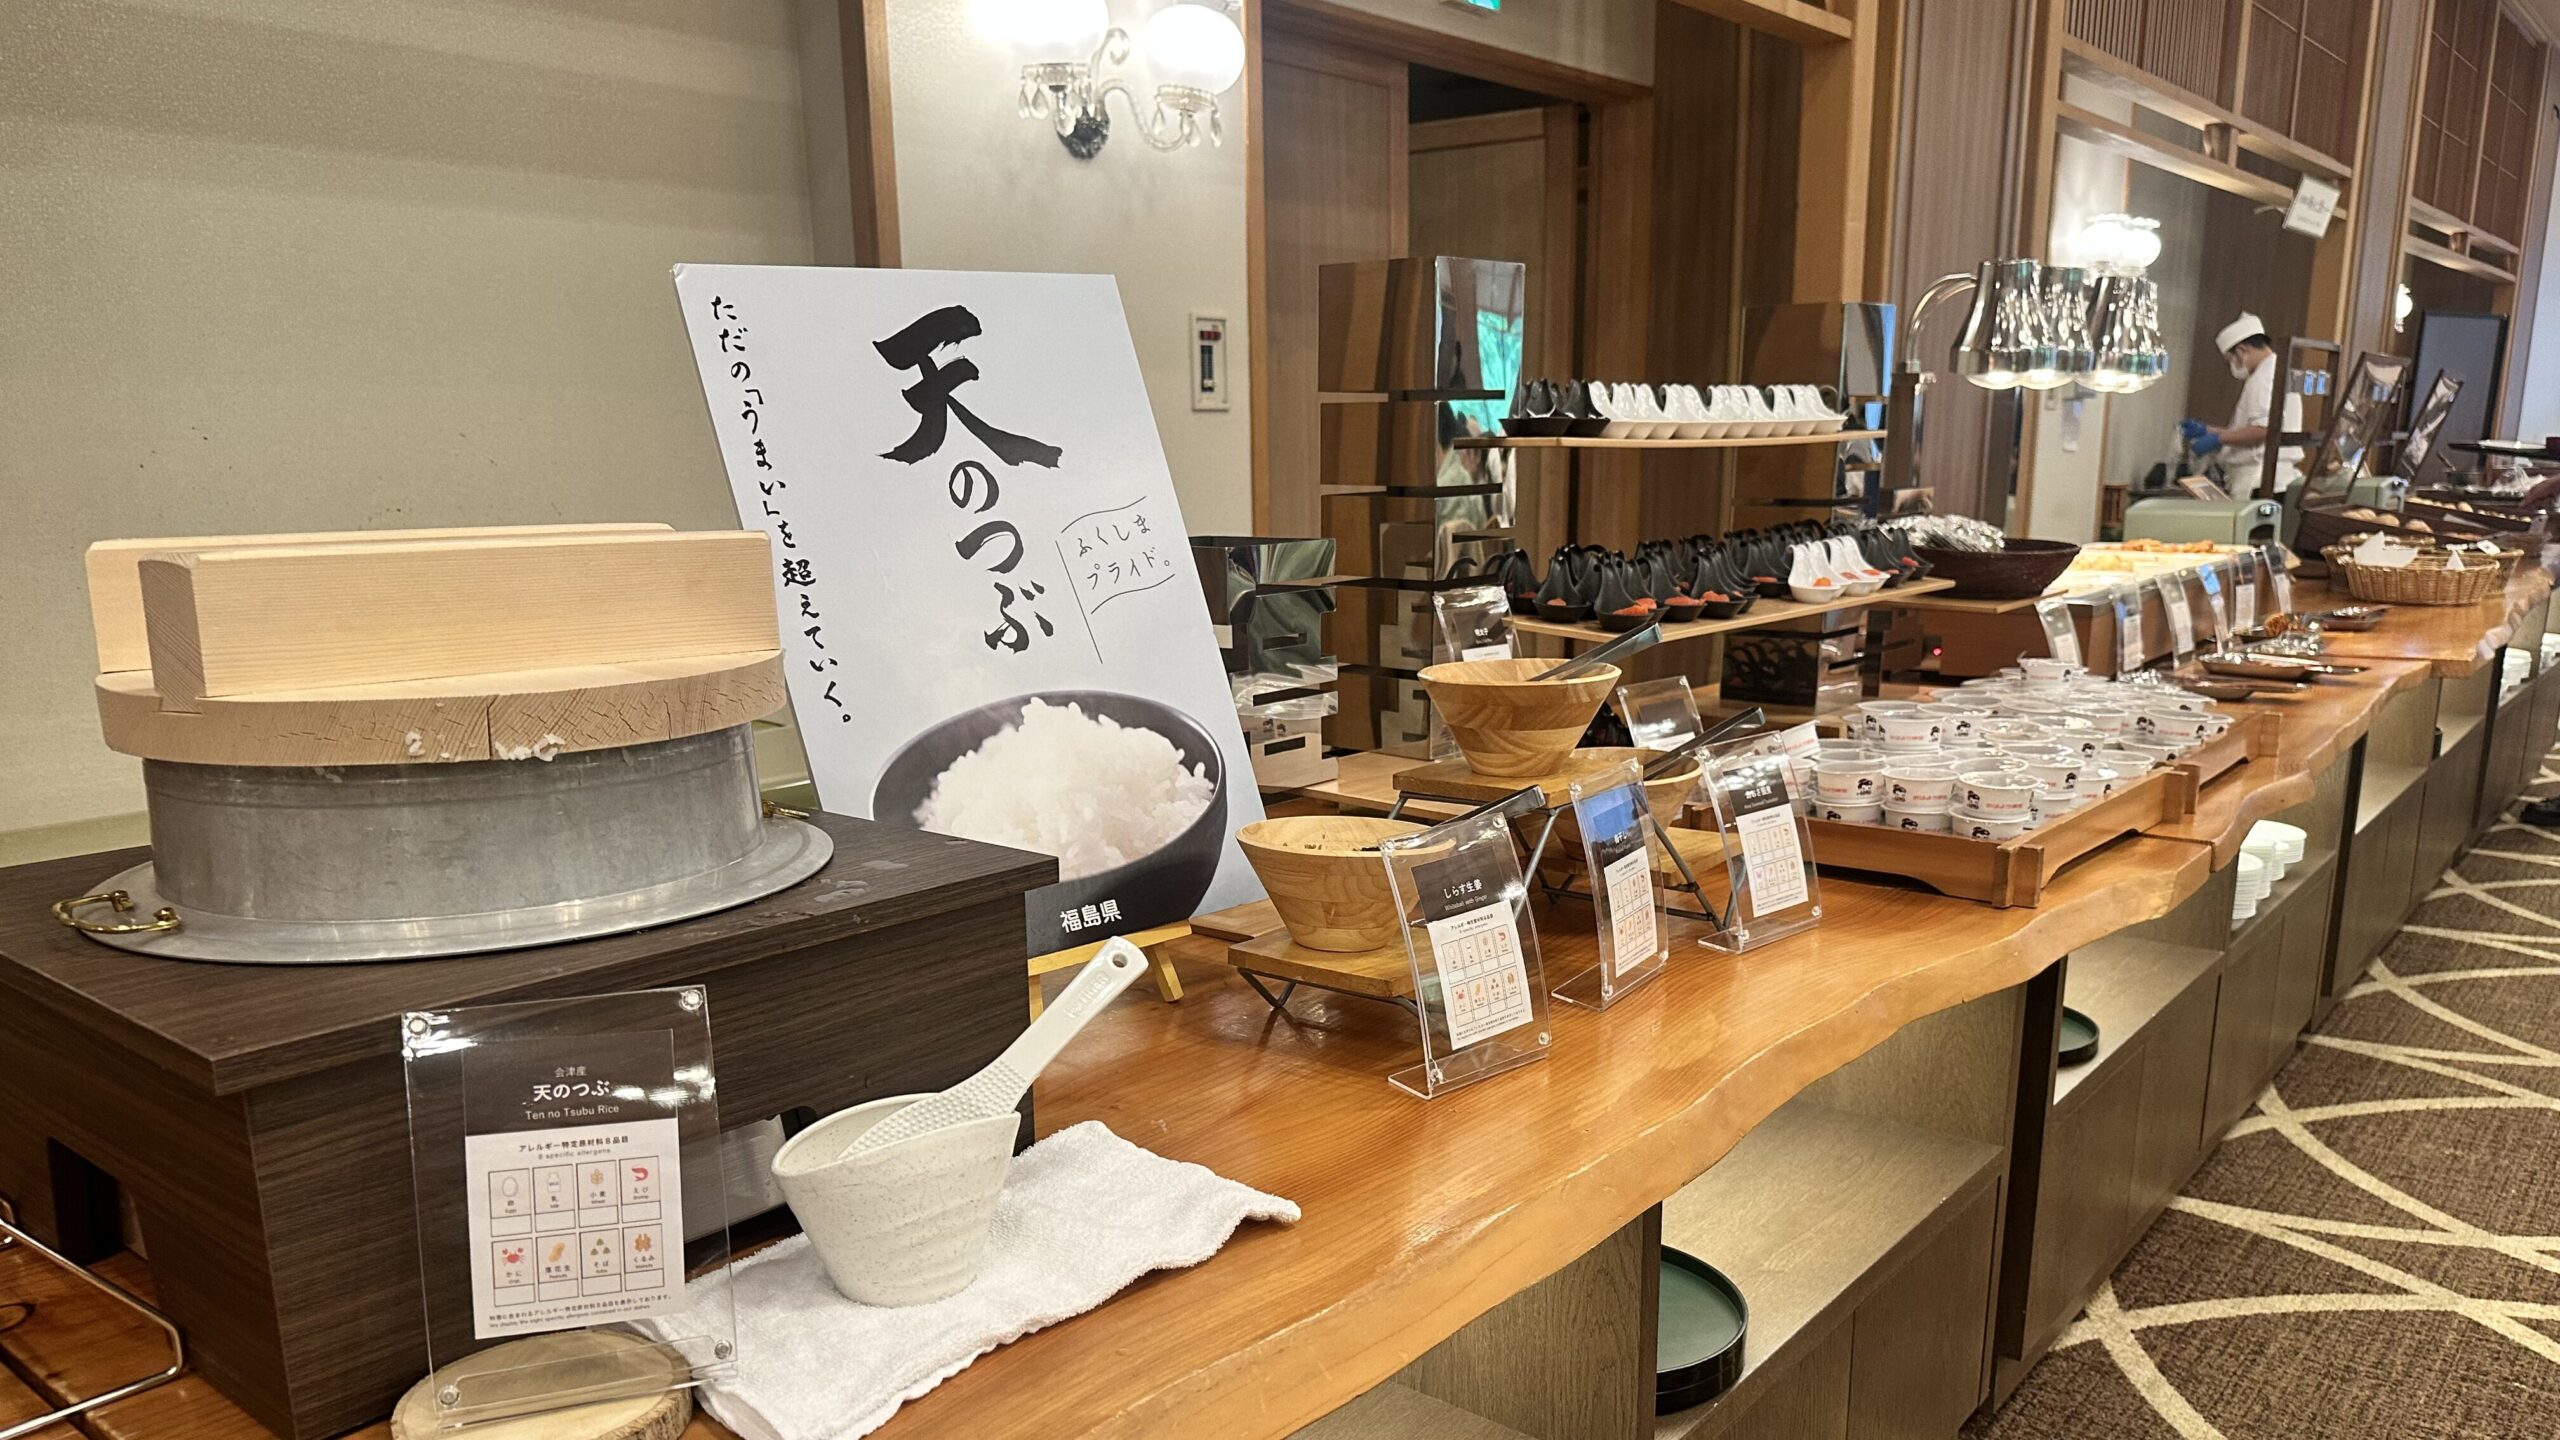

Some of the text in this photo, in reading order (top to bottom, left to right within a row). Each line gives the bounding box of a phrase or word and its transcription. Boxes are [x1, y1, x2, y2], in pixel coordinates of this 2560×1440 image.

[872, 303, 1064, 654] 天のつぶ
[710, 295, 851, 723] ただの「うまい」を超えていく。
[1077, 514, 1151, 558] ふくしま
[1086, 546, 1171, 591] プライド。
[1443, 878, 1483, 899] しらす生姜
[1059, 899, 1123, 934] 福島県
[554, 1065, 588, 1078] 会津産
[532, 1079, 611, 1102] 天のつぶ
[525, 1104, 620, 1121] Ten no Tsubu Rice
